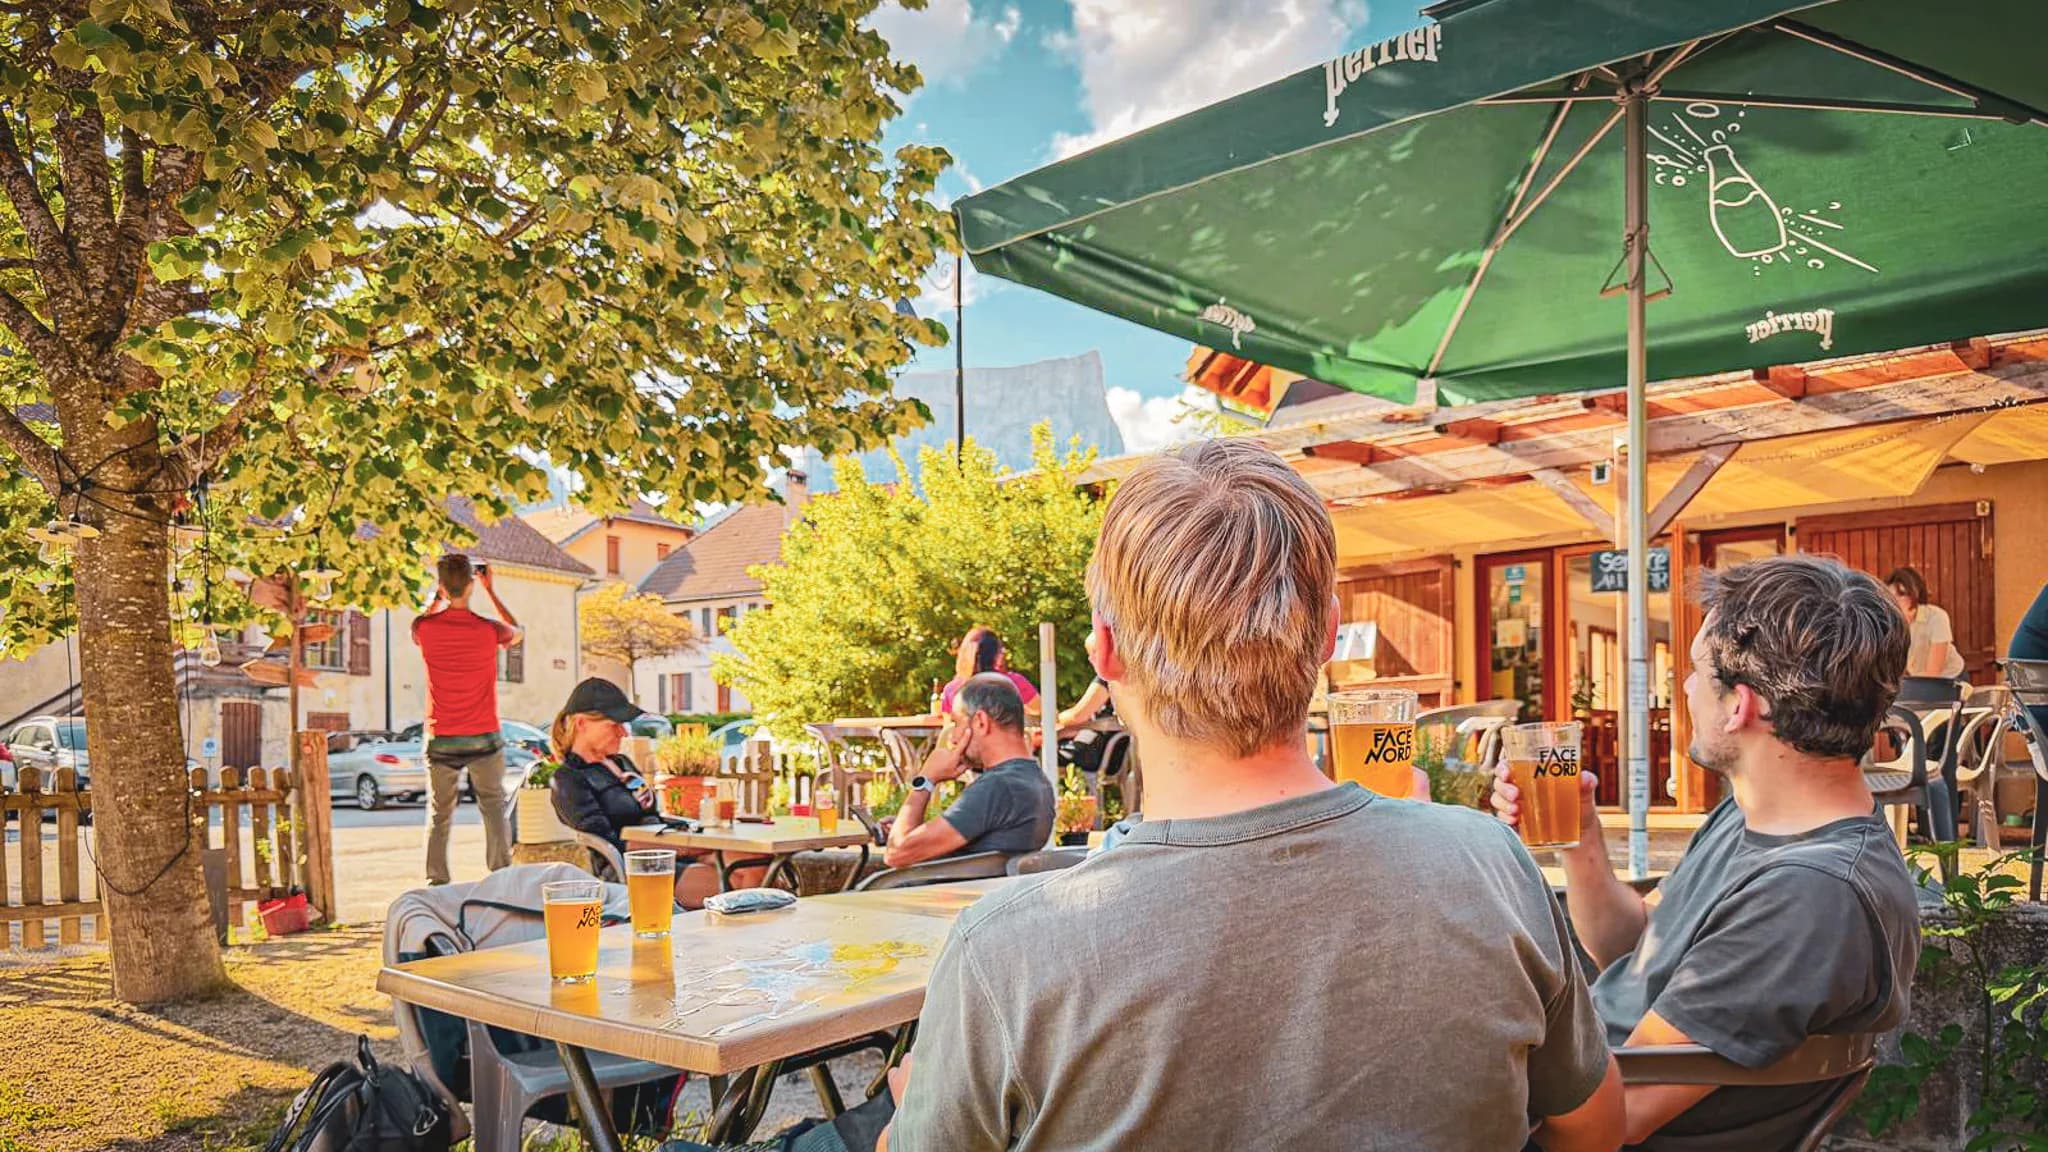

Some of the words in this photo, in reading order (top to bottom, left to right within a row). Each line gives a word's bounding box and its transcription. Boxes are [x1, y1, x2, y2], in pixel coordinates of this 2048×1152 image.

[1599, 552, 1667, 573] Sece
[1373, 729, 1412, 748] FACE
[1364, 746, 1411, 765] NORD
[1540, 748, 1576, 763] FACE
[1534, 763, 1577, 778] NORD
